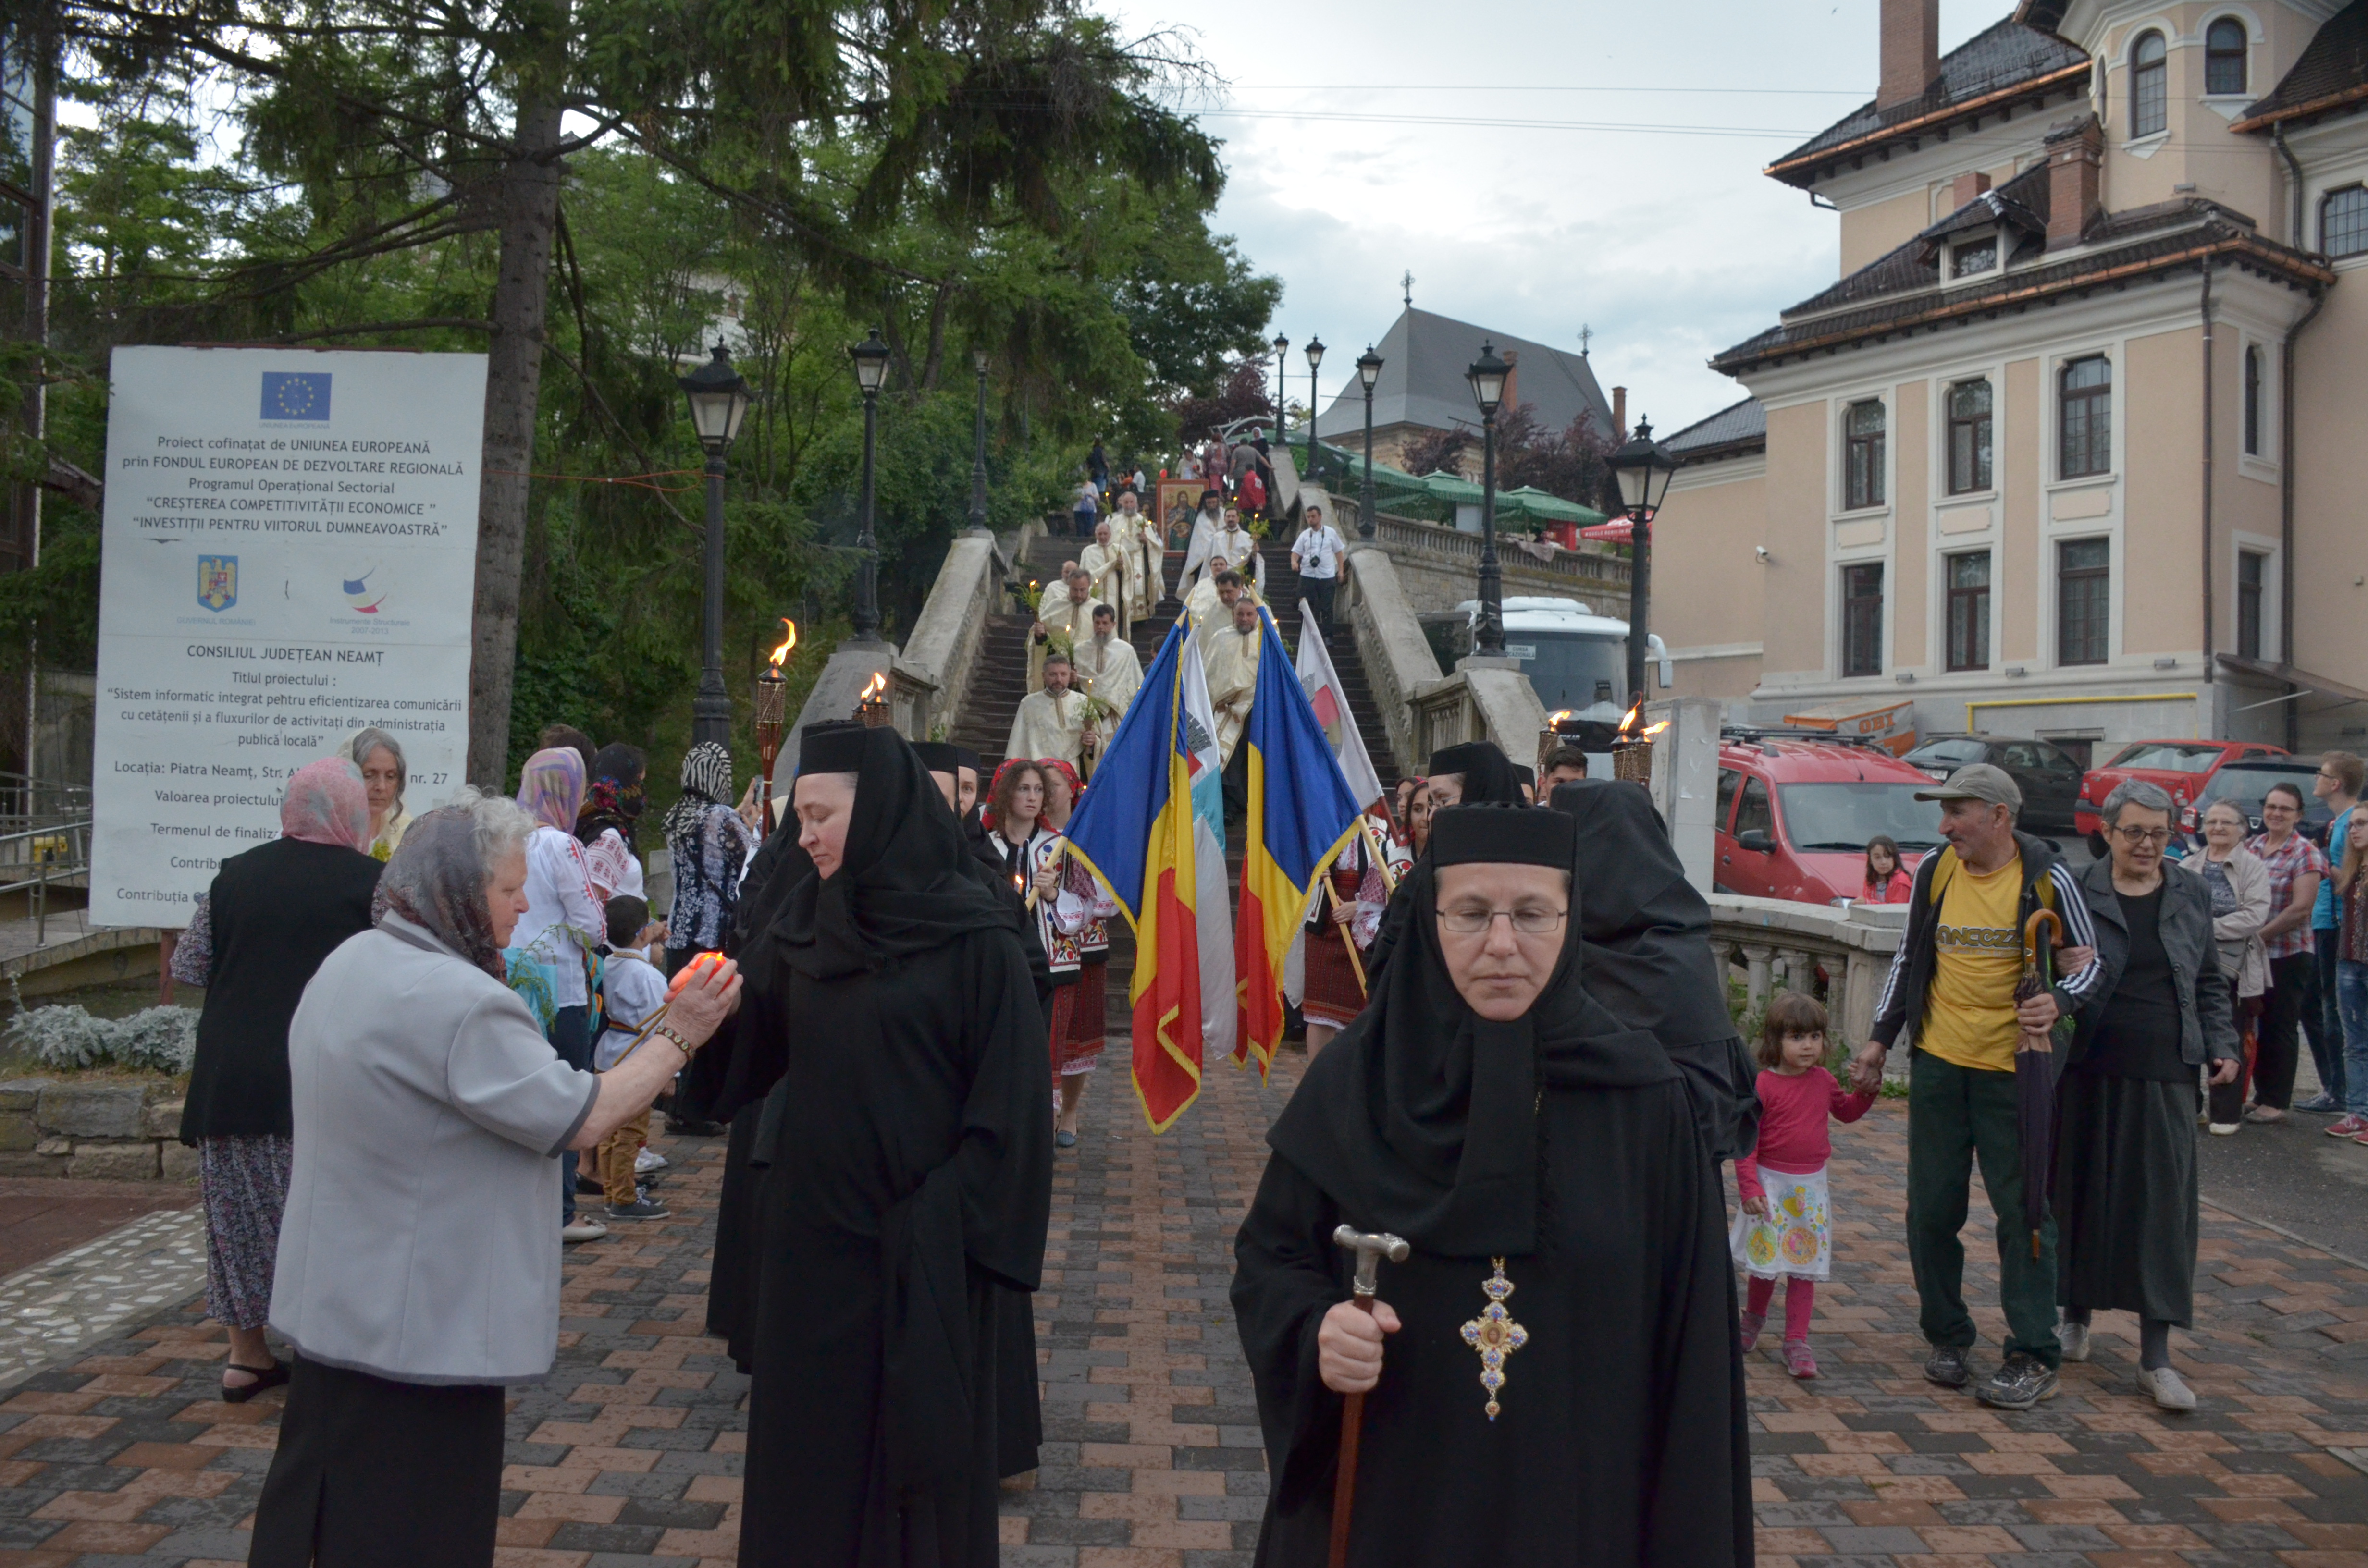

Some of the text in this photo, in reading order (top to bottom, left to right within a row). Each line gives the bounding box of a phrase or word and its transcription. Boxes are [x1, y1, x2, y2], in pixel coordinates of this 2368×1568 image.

[158, 436, 431, 454] Proiect cofinațat de UNIUNEA EUROPEANĂ
[123, 456, 464, 476] prin FONDUL EUROPEAN DE DEZVOLTARE REGIONALĂ
[189, 478, 395, 495] Programul Operațional Sectorial
[230, 498, 344, 516] COMPETITIVITĂȚII
[348, 502, 424, 514] ECONOMICE
[209, 518, 260, 530] PENTRU
[264, 520, 322, 532] VIITORUL
[187, 645, 384, 666] CONSILIUL JUDEȚEAN NEAMȚ
[232, 671, 261, 684] Titlul
[265, 673, 329, 686] proiectului
[108, 687, 462, 711] “Sistem informatic integrat pentru eficientizarea comunicării
[121, 711, 134, 720] cu
[138, 710, 189, 724] cetățenii
[193, 711, 201, 725] și
[216, 711, 269, 725] fluxurilor
[274, 714, 287, 726] de
[347, 717, 365, 728] din
[369, 717, 445, 734] administrația
[1858, 712, 1896, 734] OBI
[238, 734, 280, 747] publică
[115, 761, 165, 776] Locația:
[170, 763, 208, 775] Piatra
[212, 765, 257, 780] Neamț,
[263, 766, 283, 778] Str.
[410, 774, 427, 784] nr.
[433, 772, 448, 784] 27
[155, 790, 210, 804] Valoarea
[151, 823, 210, 837] Termenul
[215, 825, 231, 837] de
[117, 888, 188, 905] Contribuția
